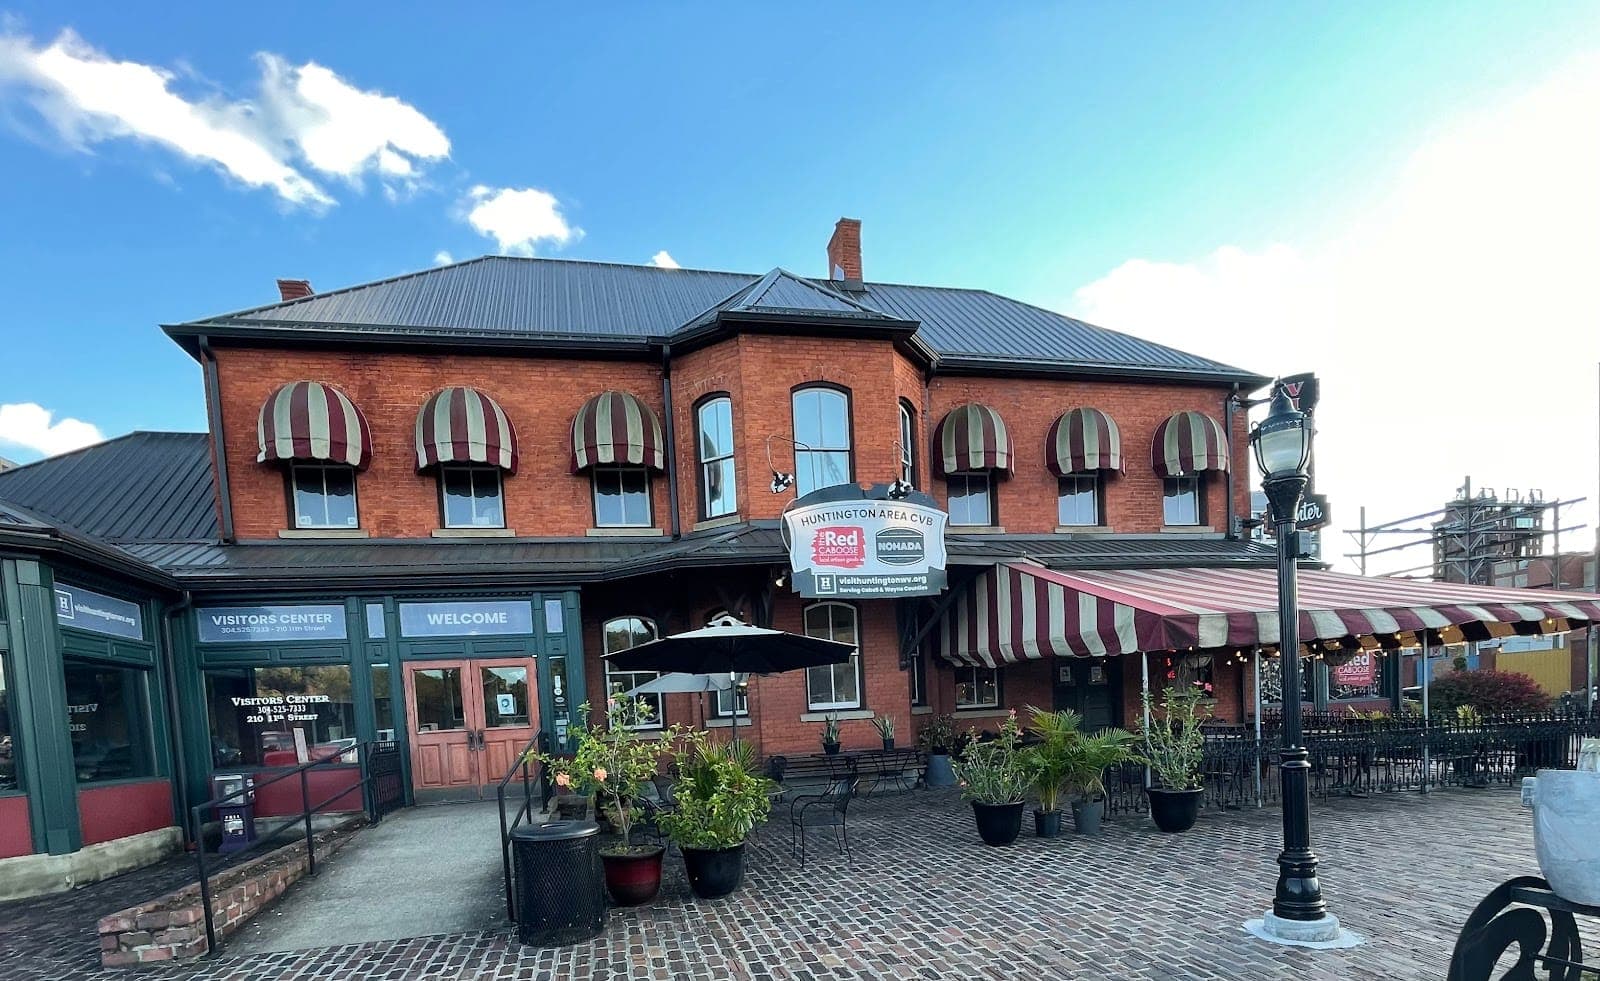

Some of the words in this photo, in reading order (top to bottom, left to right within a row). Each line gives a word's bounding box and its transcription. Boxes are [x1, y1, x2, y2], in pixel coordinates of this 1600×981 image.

[801, 509, 876, 527] HUNTINGTON
[879, 510, 907, 520] AREA
[910, 513, 934, 526] CVB
[825, 530, 858, 546] Red
[877, 542, 922, 551] NOMADA
[839, 576, 927, 586] visithuntingtonwv.org
[212, 614, 277, 626] VISITORS
[280, 613, 332, 624] CENTER
[427, 612, 508, 626] WELCOME
[257, 704, 306, 714] 304-525-7333
[246, 715, 264, 723] 210
[267, 714, 285, 722] 11th
